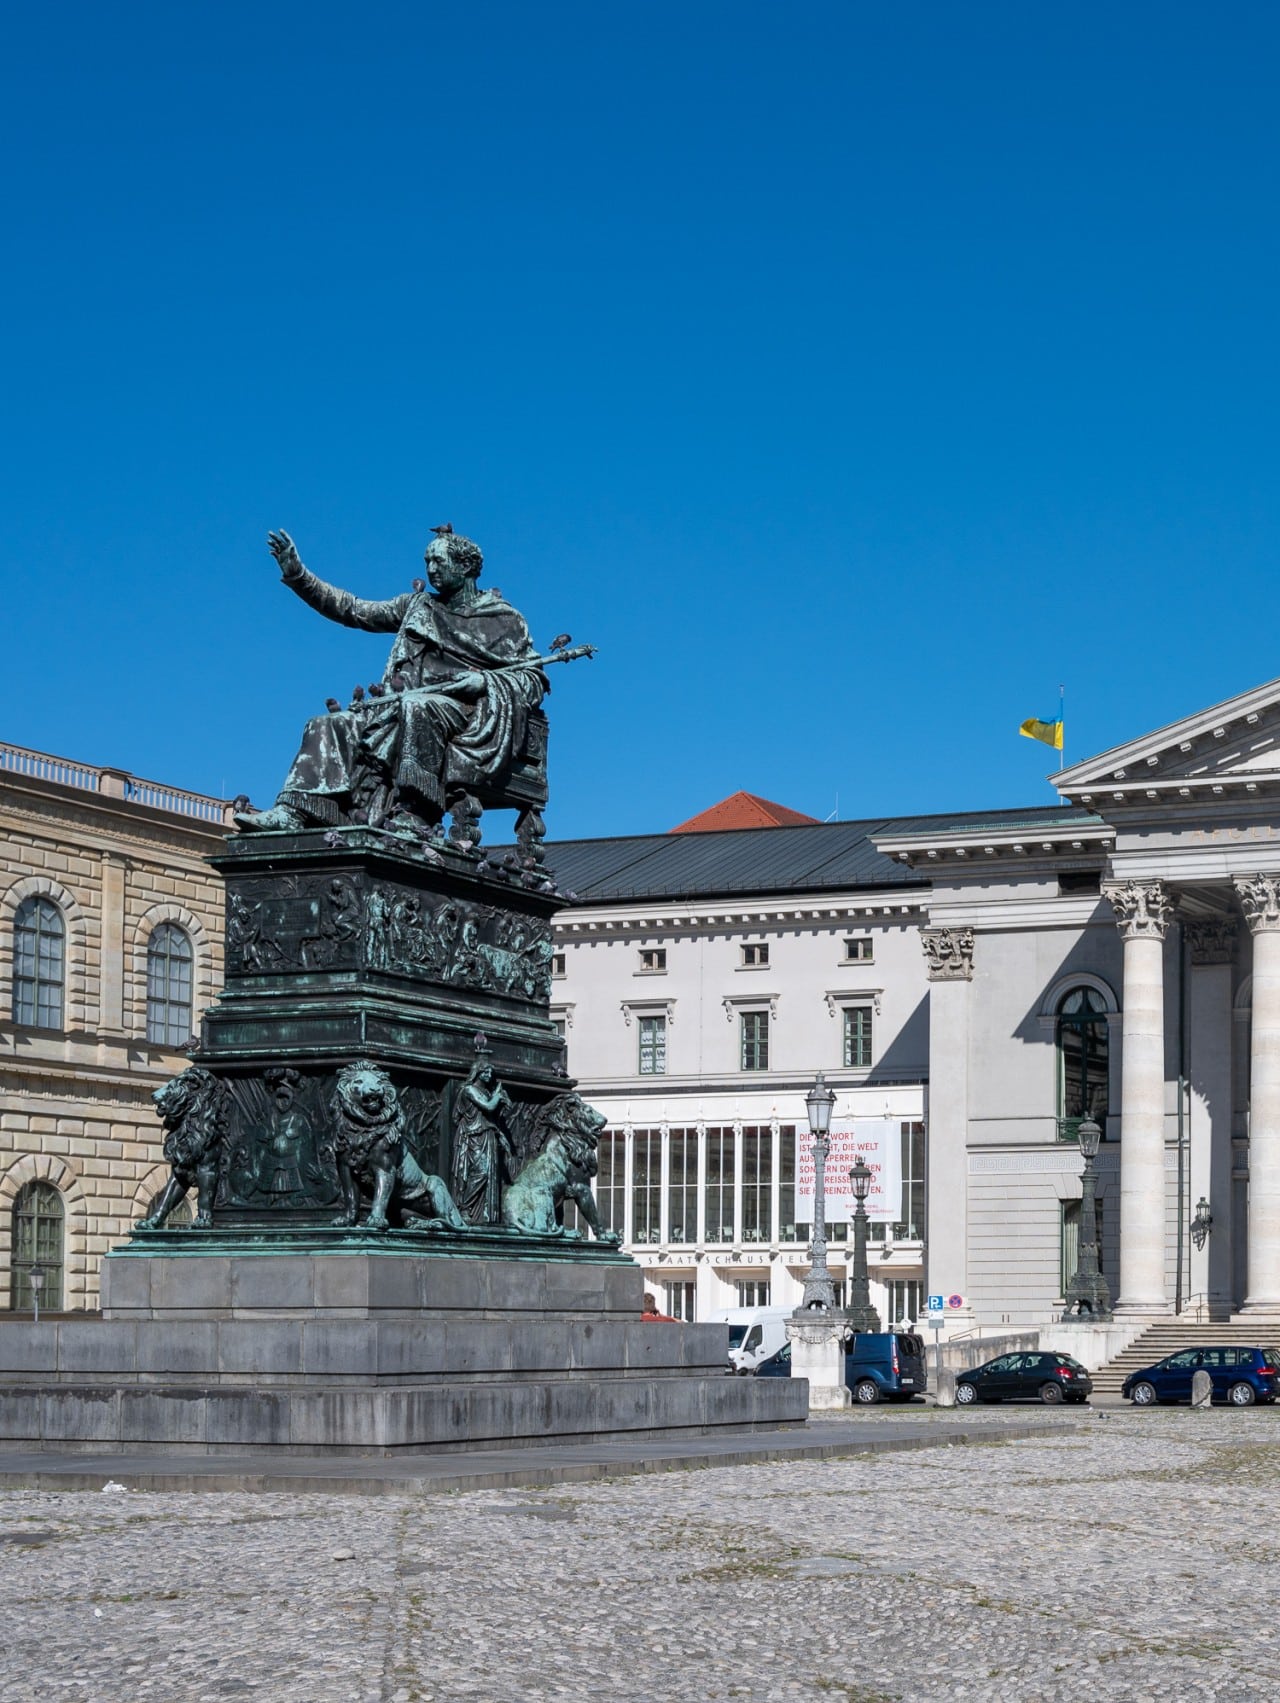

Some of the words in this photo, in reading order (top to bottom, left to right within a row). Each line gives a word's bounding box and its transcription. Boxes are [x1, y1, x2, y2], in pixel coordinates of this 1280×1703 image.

[799, 1133, 812, 1142] DIE
[814, 1132, 855, 1141] WORT
[799, 1144, 811, 1152] IST
[842, 1143, 855, 1151] DIE
[857, 1142, 879, 1151] WELT
[799, 1165, 838, 1173] SONERN
[799, 1175, 852, 1184] AUFREISSE
[799, 1186, 811, 1195] SIE
[648, 1255, 805, 1265] SAATSCHUSIEL
[930, 1297, 940, 1308] P
